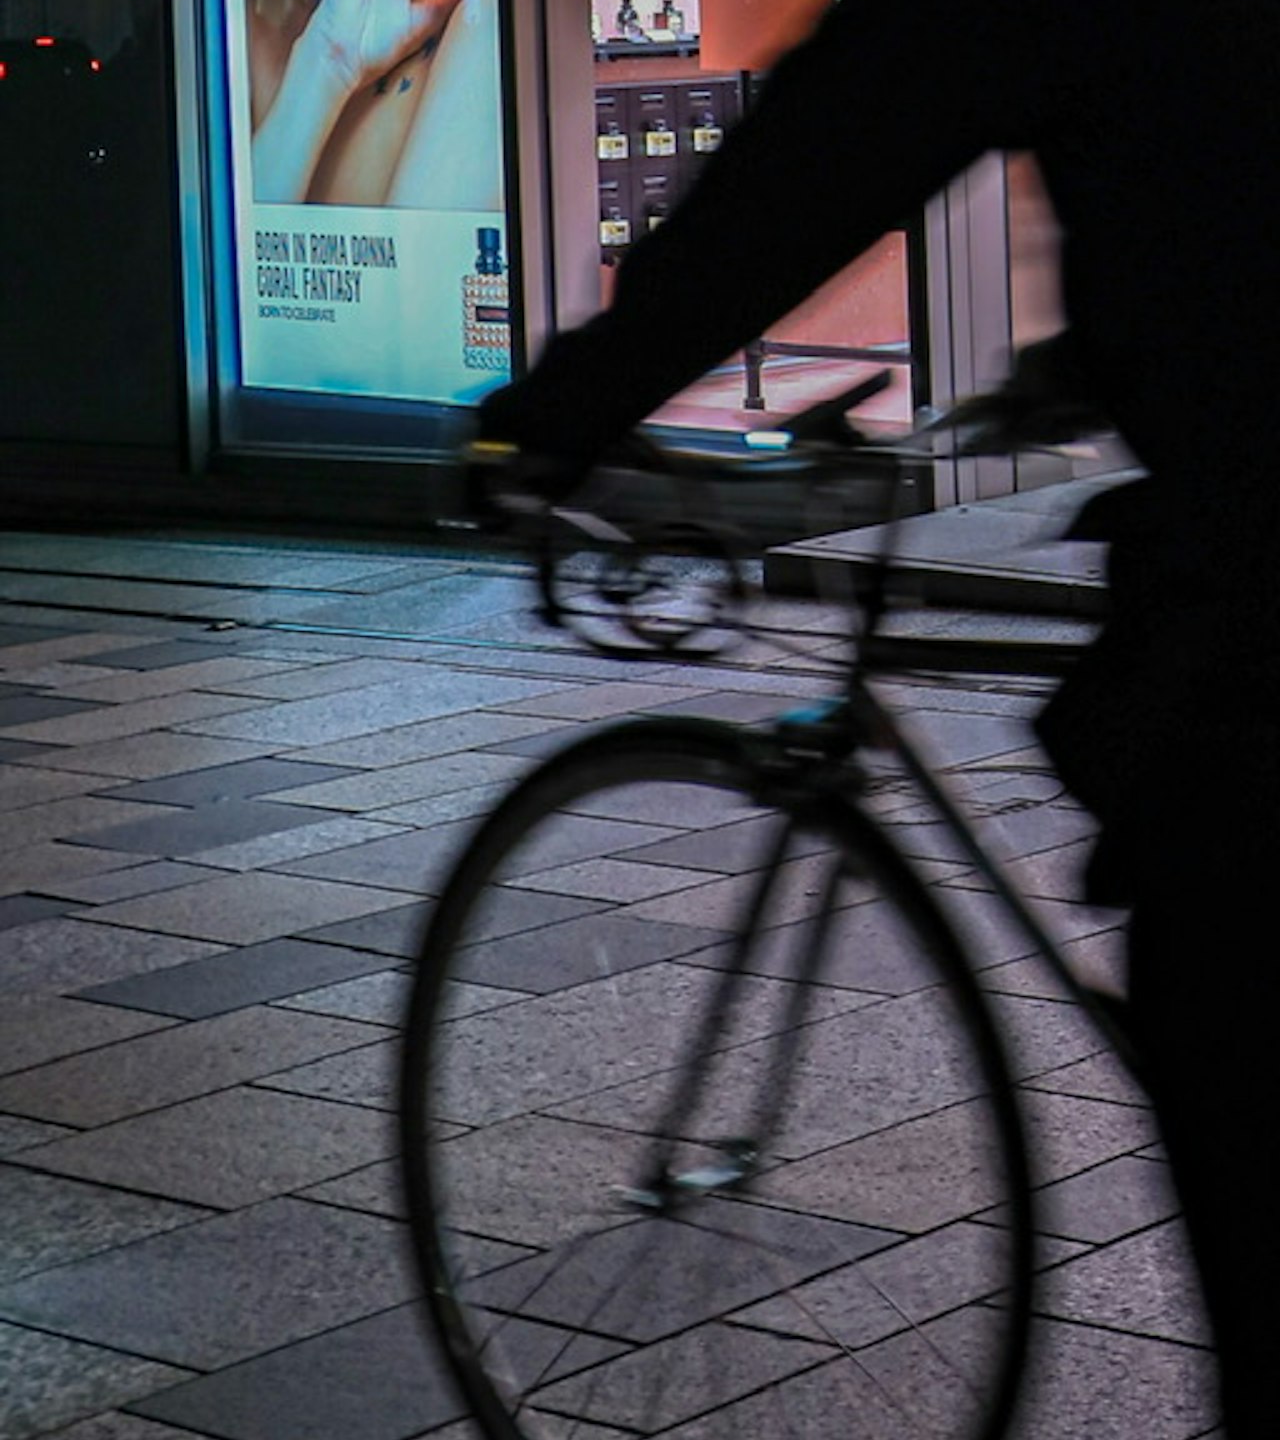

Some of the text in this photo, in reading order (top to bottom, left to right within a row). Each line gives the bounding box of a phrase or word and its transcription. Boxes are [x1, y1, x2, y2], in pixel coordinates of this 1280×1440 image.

[255, 232, 397, 268] BORN IN ROMA DONNA
[257, 265, 362, 303] CORAL FANTASY
